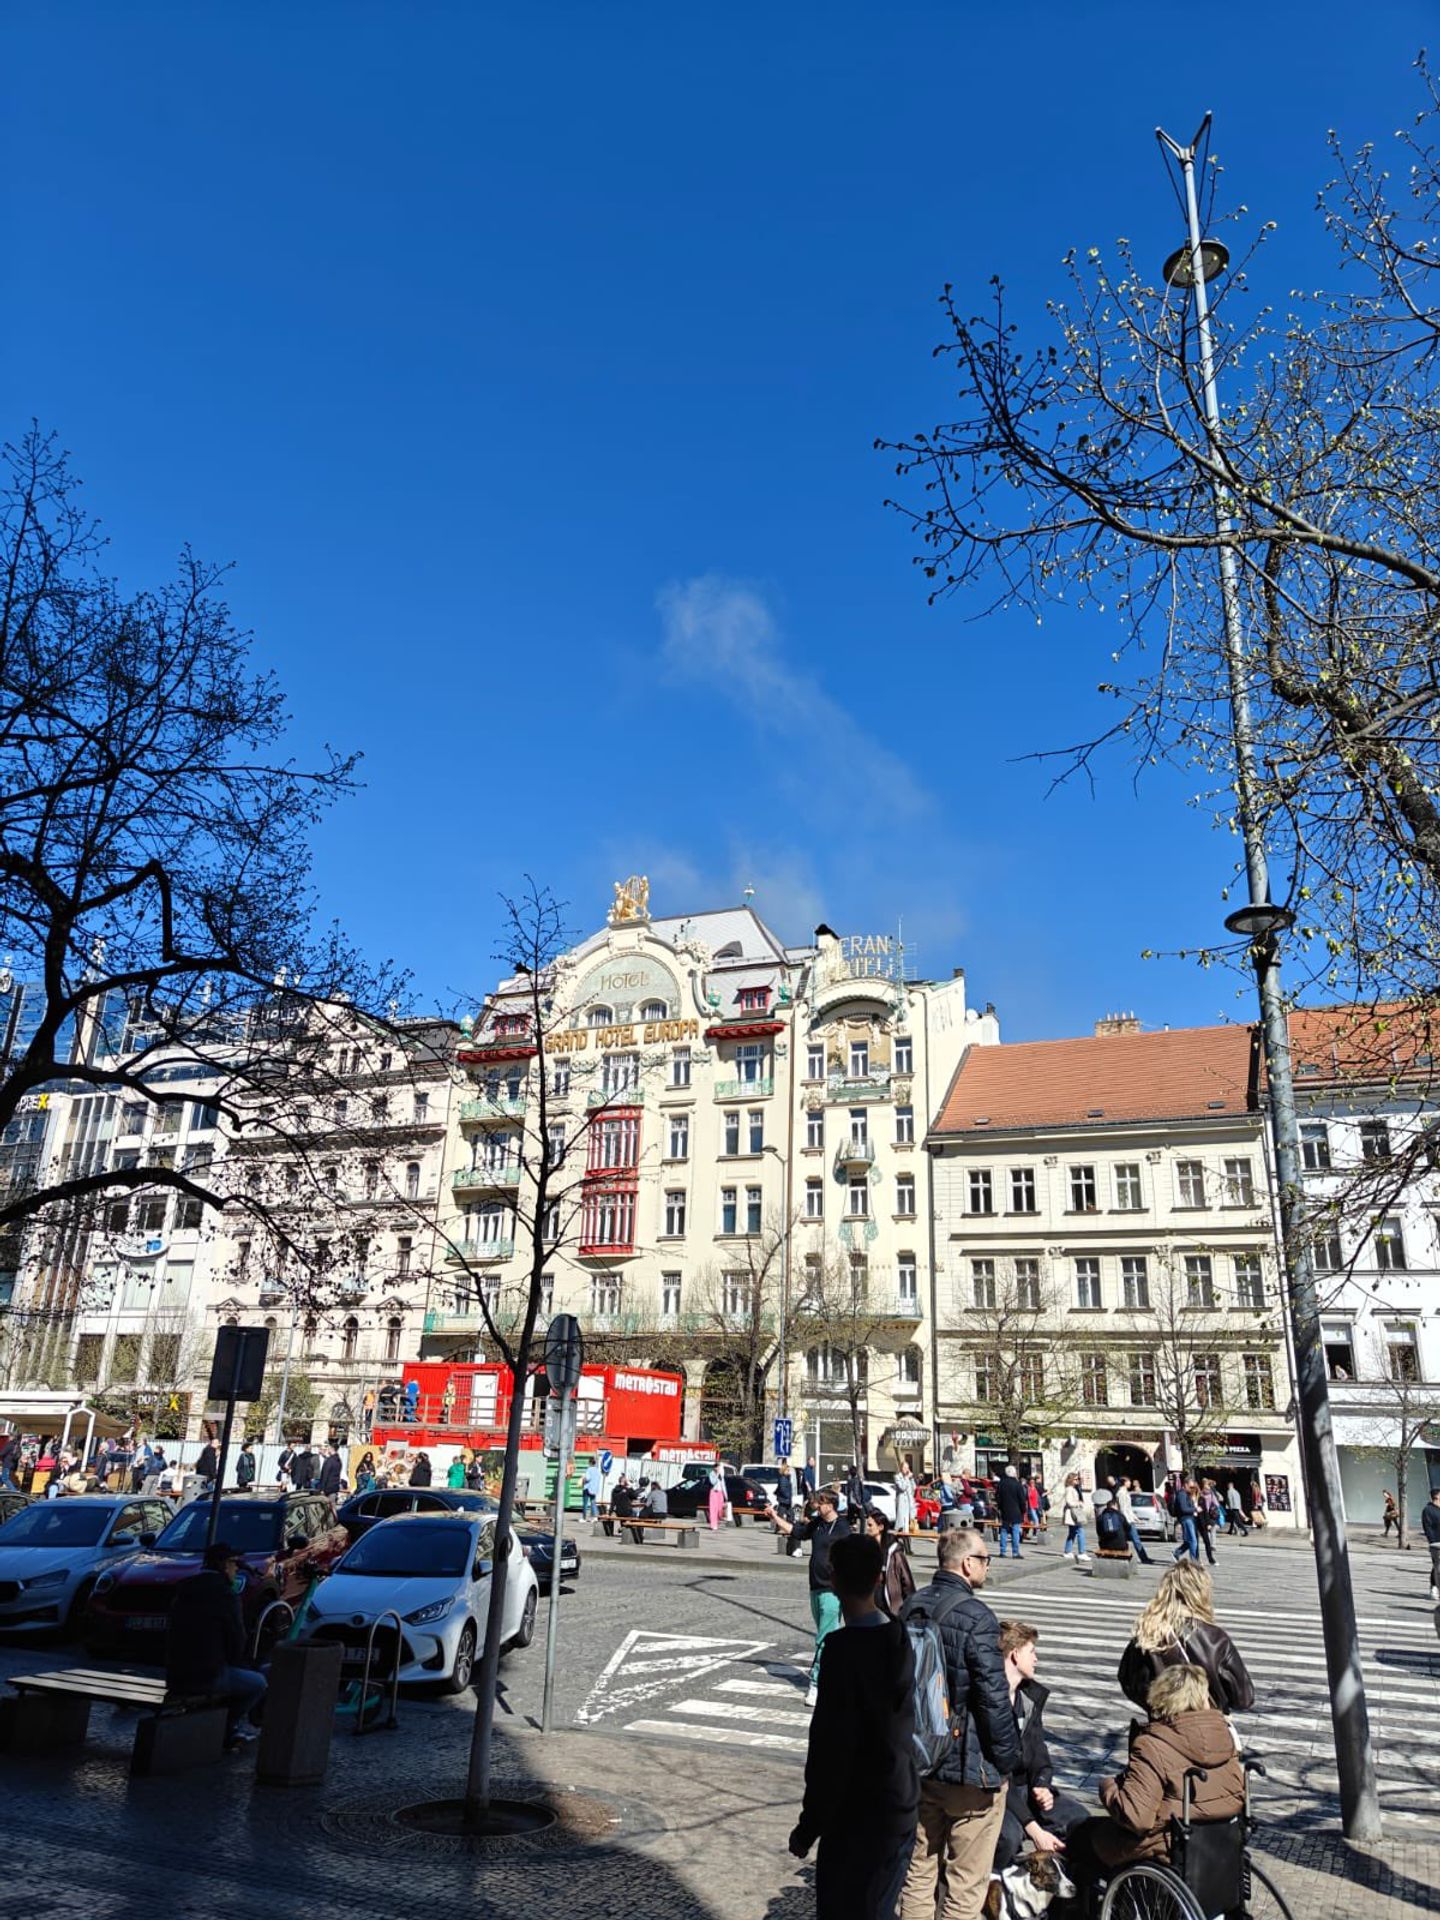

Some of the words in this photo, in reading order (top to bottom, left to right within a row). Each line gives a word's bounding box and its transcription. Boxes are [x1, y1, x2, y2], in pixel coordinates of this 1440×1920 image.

[545, 1030, 588, 1053] GRAND
[596, 1024, 638, 1048] HOTEL
[643, 1018, 699, 1043] EUROPA
